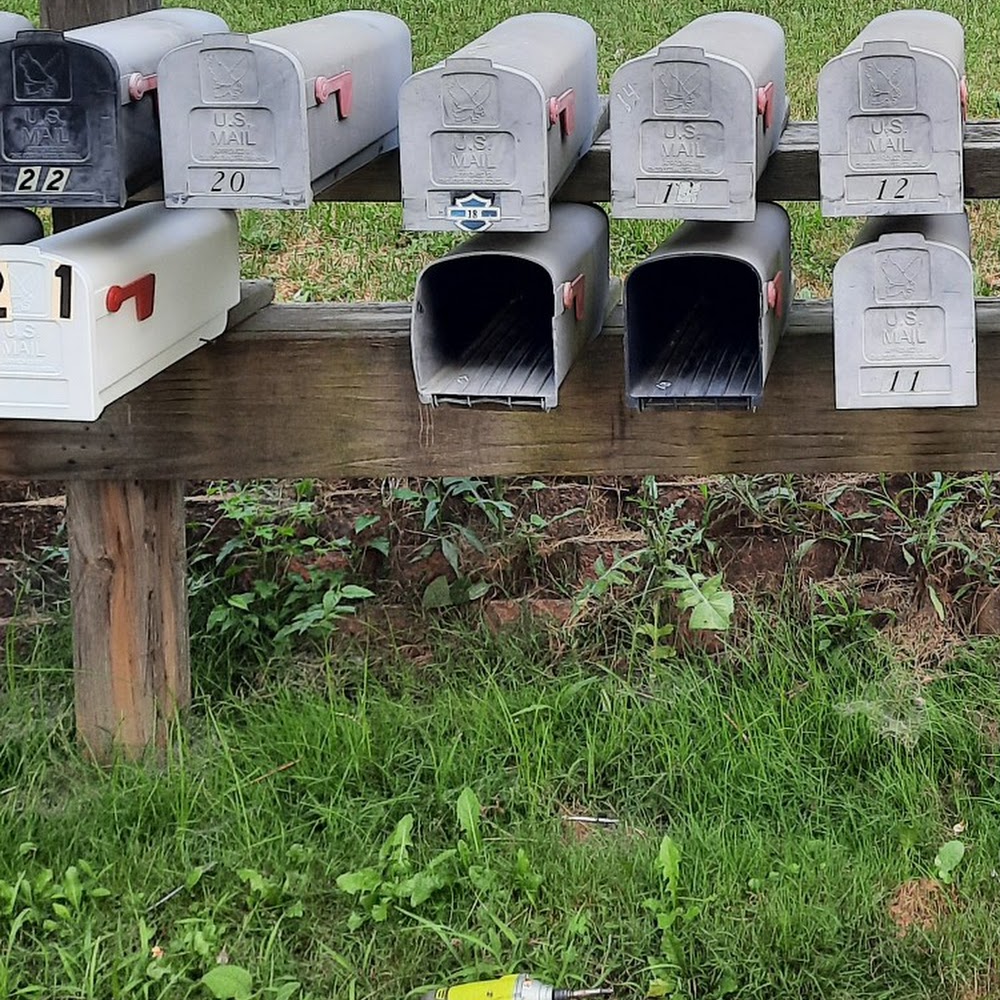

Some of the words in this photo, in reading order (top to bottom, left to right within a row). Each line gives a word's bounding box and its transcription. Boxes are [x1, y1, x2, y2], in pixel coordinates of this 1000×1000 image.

[214, 112, 251, 127] U.S.
[871, 119, 907, 135] U.S.
[21, 127, 69, 145] MAIL
[210, 131, 256, 146] MAIL
[664, 124, 701, 139] U.S.
[455, 134, 492, 151] U.S.
[661, 143, 706, 158] MAIL
[868, 138, 913, 152] MAIL
[450, 153, 497, 169] MAIL
[18, 168, 65, 191] 22
[211, 171, 245, 192] 20
[877, 178, 908, 200] 12
[885, 311, 922, 327] U.S.
[882, 329, 926, 345] MAIL
[889, 370, 920, 392] 11
